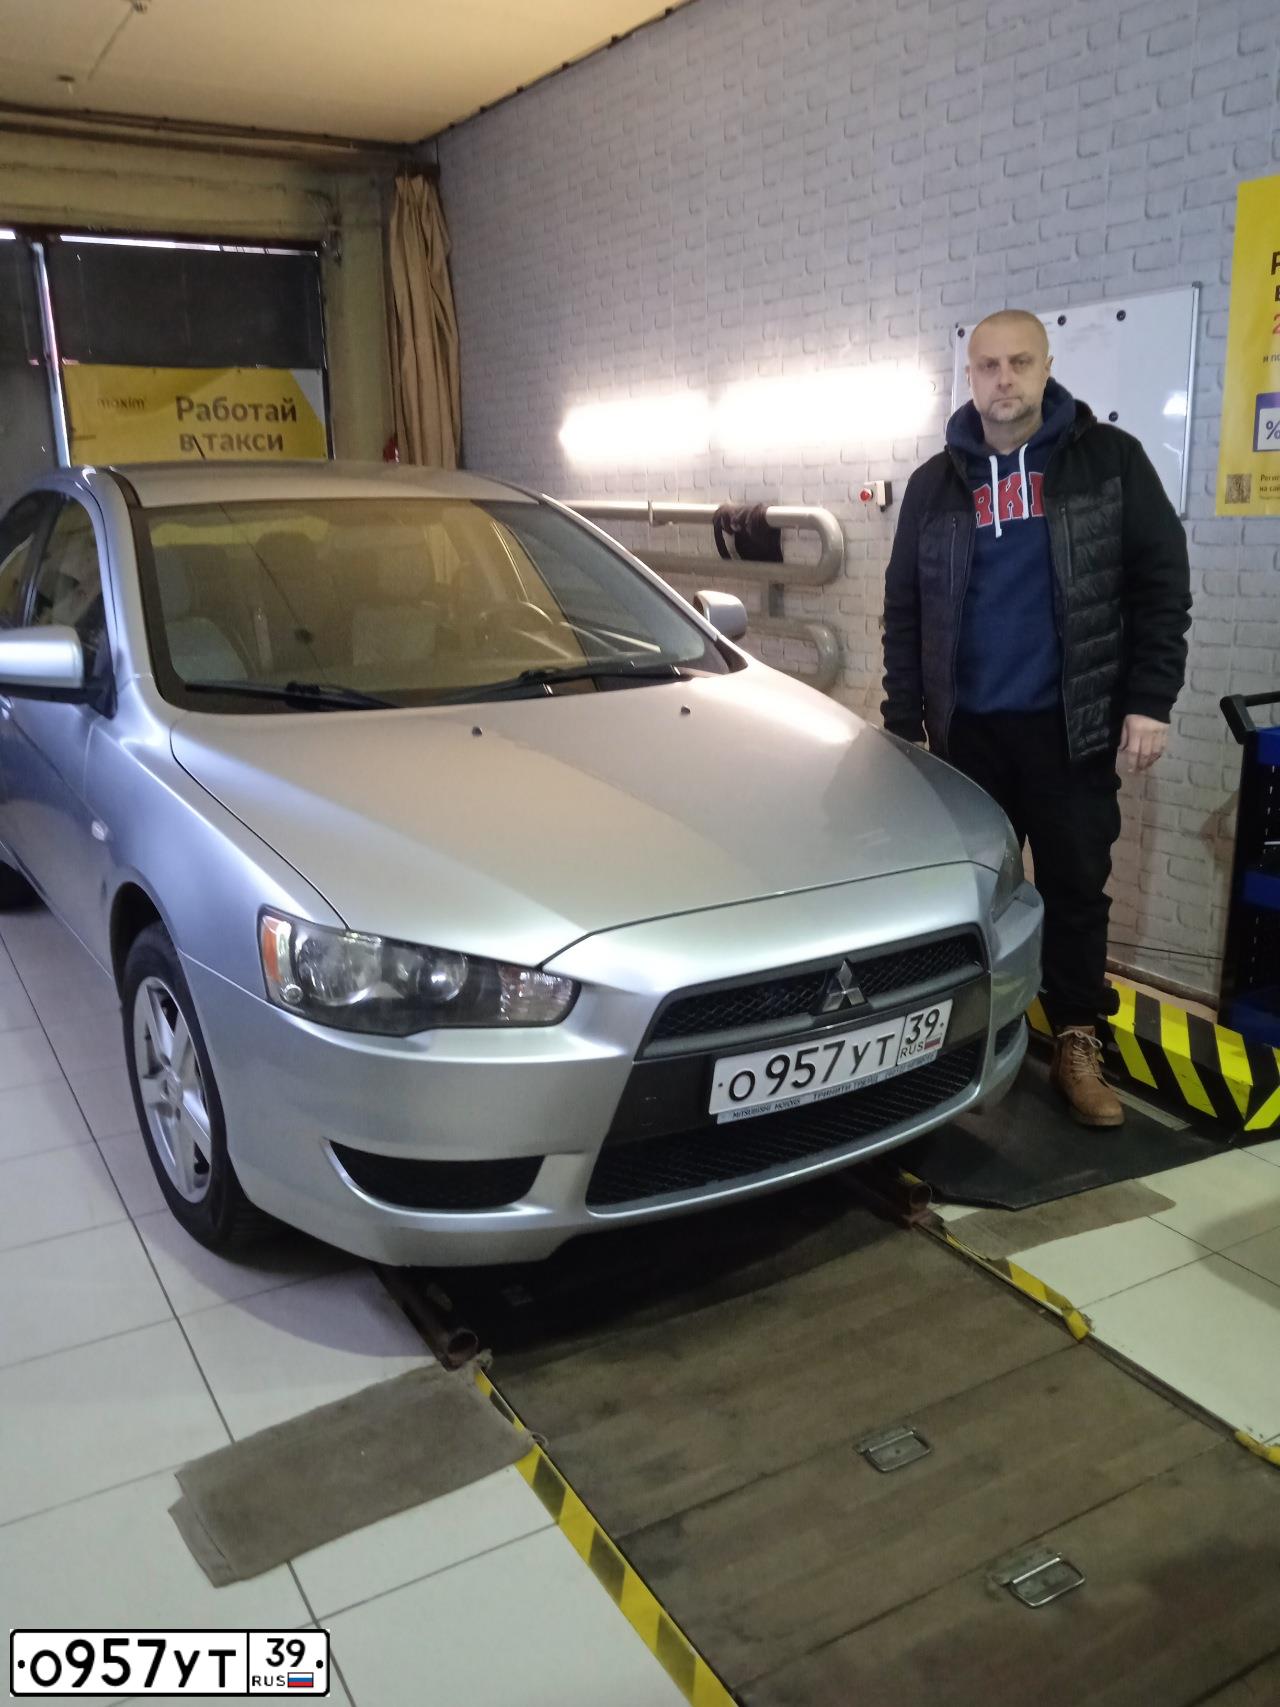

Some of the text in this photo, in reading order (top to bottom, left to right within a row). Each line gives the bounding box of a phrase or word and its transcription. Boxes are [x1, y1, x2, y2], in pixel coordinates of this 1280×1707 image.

[175, 396, 298, 423] Работай
[179, 431, 284, 452] в такси
[905, 1008, 940, 1045] 39
[900, 1040, 924, 1058] RUS
[732, 1103, 772, 1119] MITSUBISHI
